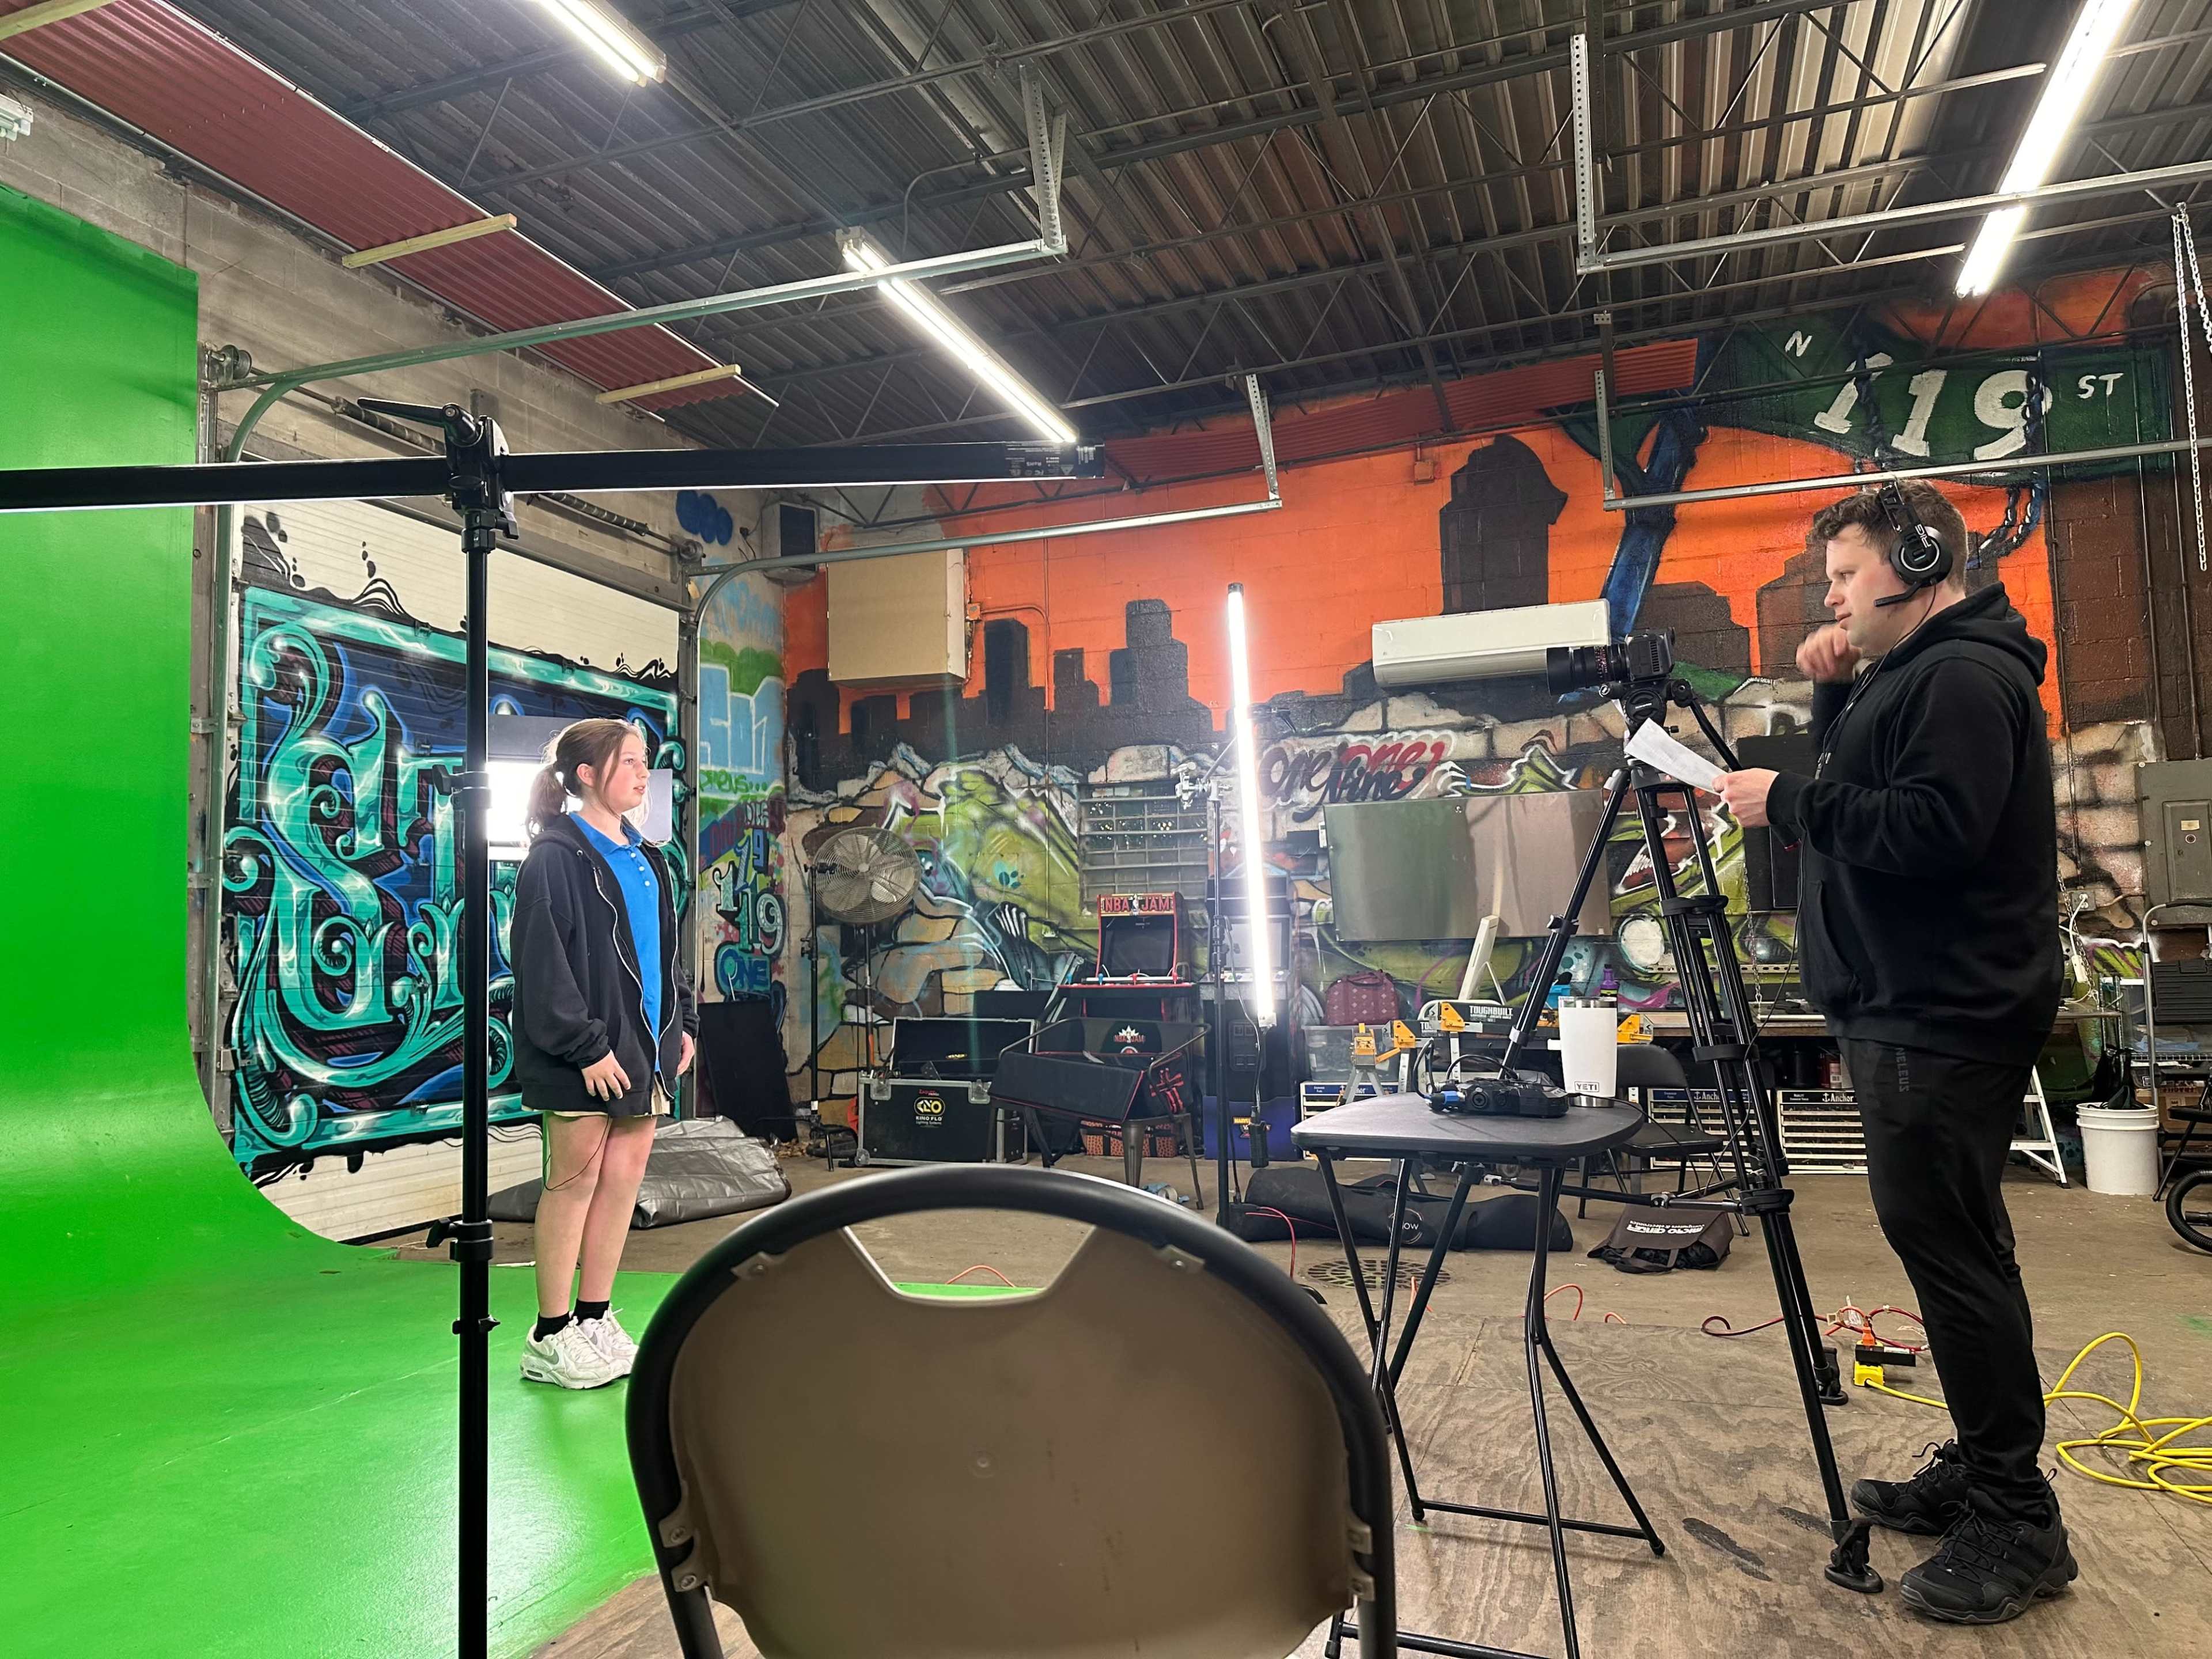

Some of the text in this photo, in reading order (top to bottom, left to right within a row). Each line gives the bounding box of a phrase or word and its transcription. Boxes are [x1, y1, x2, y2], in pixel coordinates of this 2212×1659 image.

[1785, 329, 2124, 461] N 119 ST
[1915, 524, 1931, 548] RIG
[1104, 896, 1170, 912] NBA JAM
[1469, 1005, 1513, 1016] TOUGHBUILT
[1895, 1047, 1910, 1092] NELEUS
[1830, 1093, 1854, 1103] Anchor
